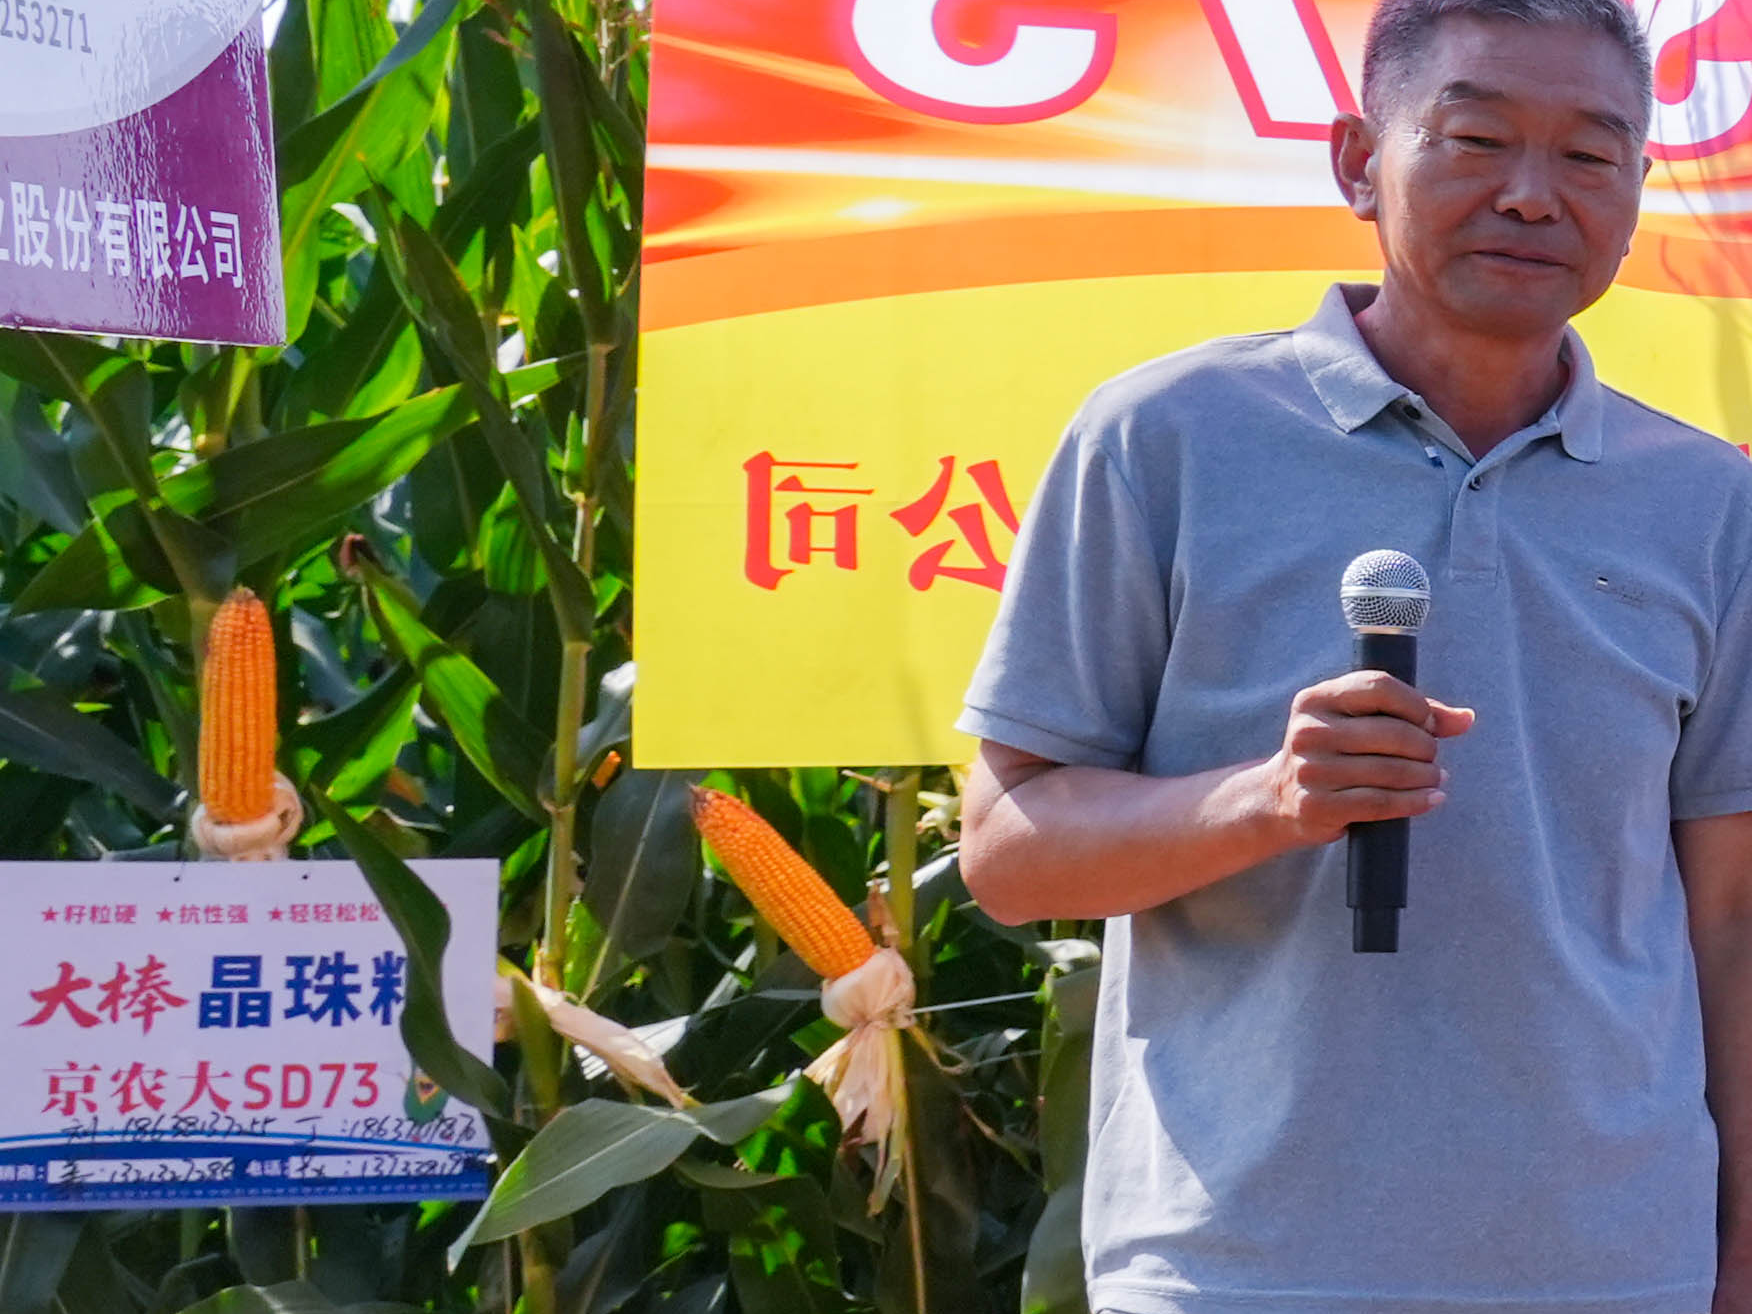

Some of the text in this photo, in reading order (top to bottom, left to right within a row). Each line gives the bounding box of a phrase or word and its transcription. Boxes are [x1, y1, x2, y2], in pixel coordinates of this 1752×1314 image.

[179, 903, 250, 925] 抗性强
[41, 1061, 380, 1117] 京农大SD73
